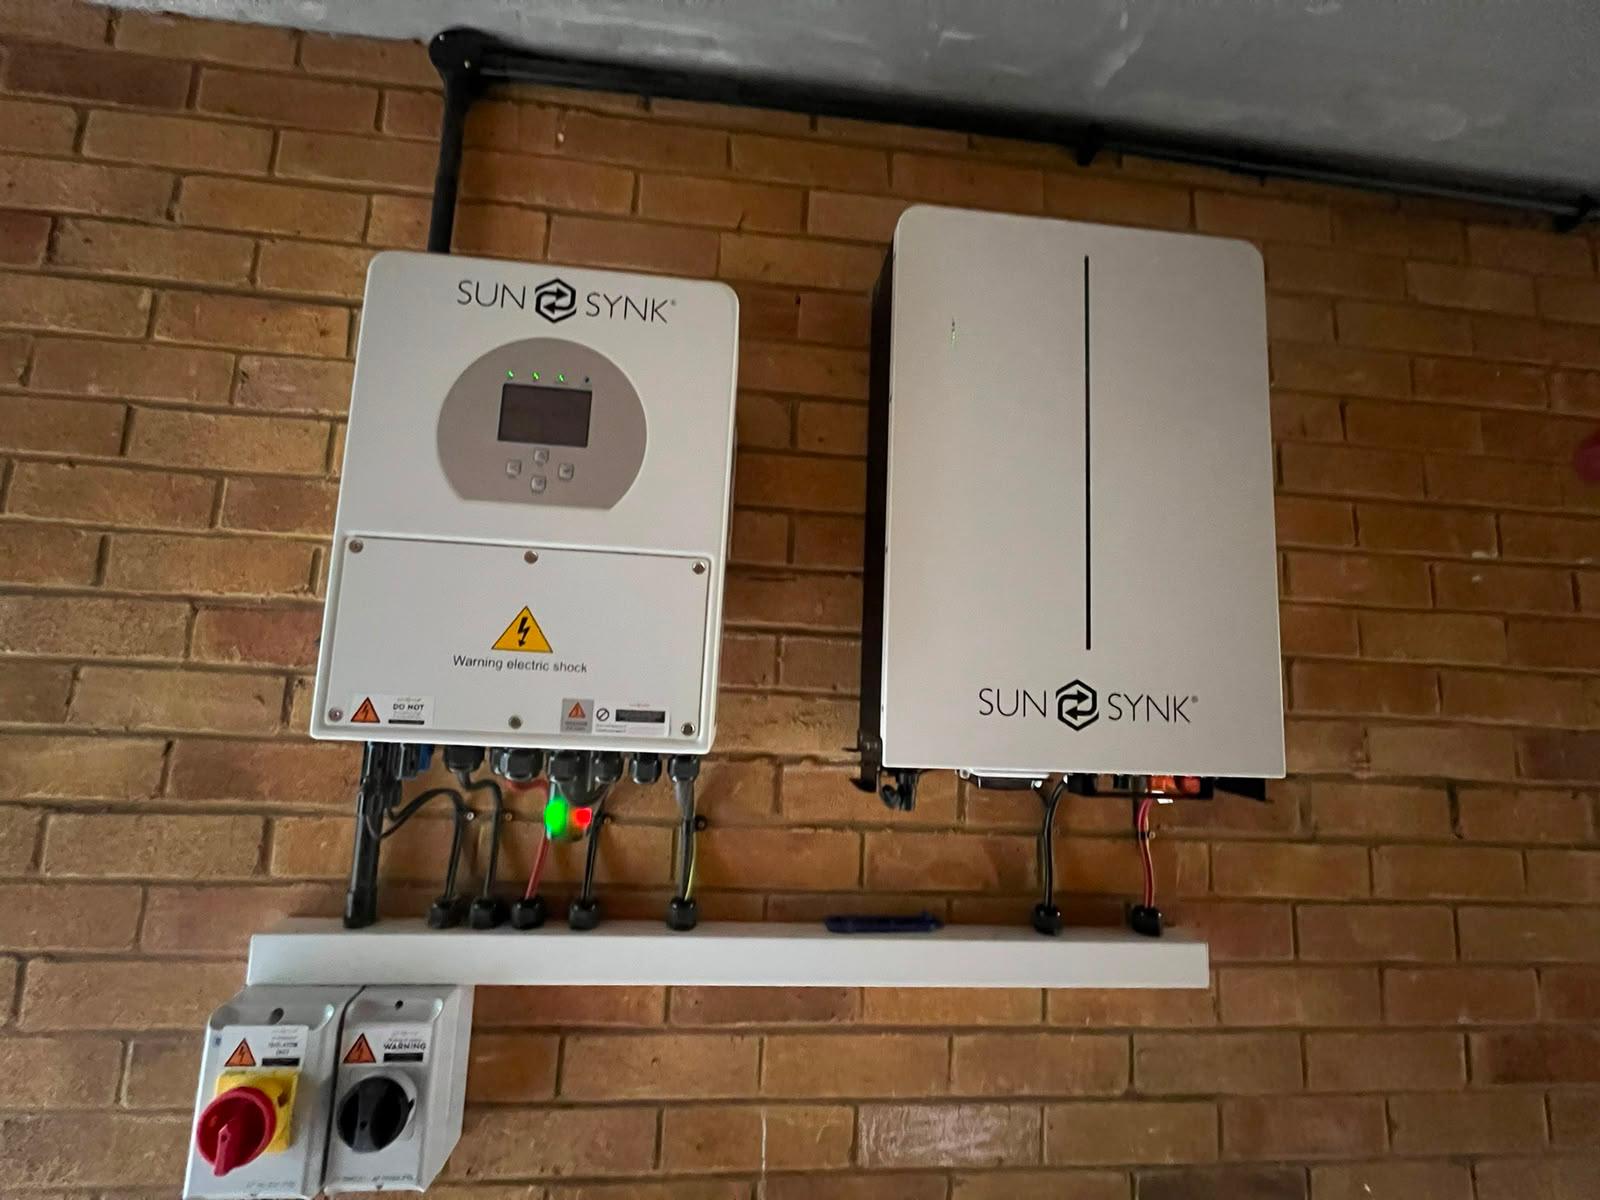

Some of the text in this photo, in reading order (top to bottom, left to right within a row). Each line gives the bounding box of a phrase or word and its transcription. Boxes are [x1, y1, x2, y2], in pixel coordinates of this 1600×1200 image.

[457, 280, 668, 324] SUN SYNK
[453, 654, 587, 673] Warning electric shock
[978, 687, 1191, 723] SUN SYNK
[384, 1042, 426, 1050] WARNING
